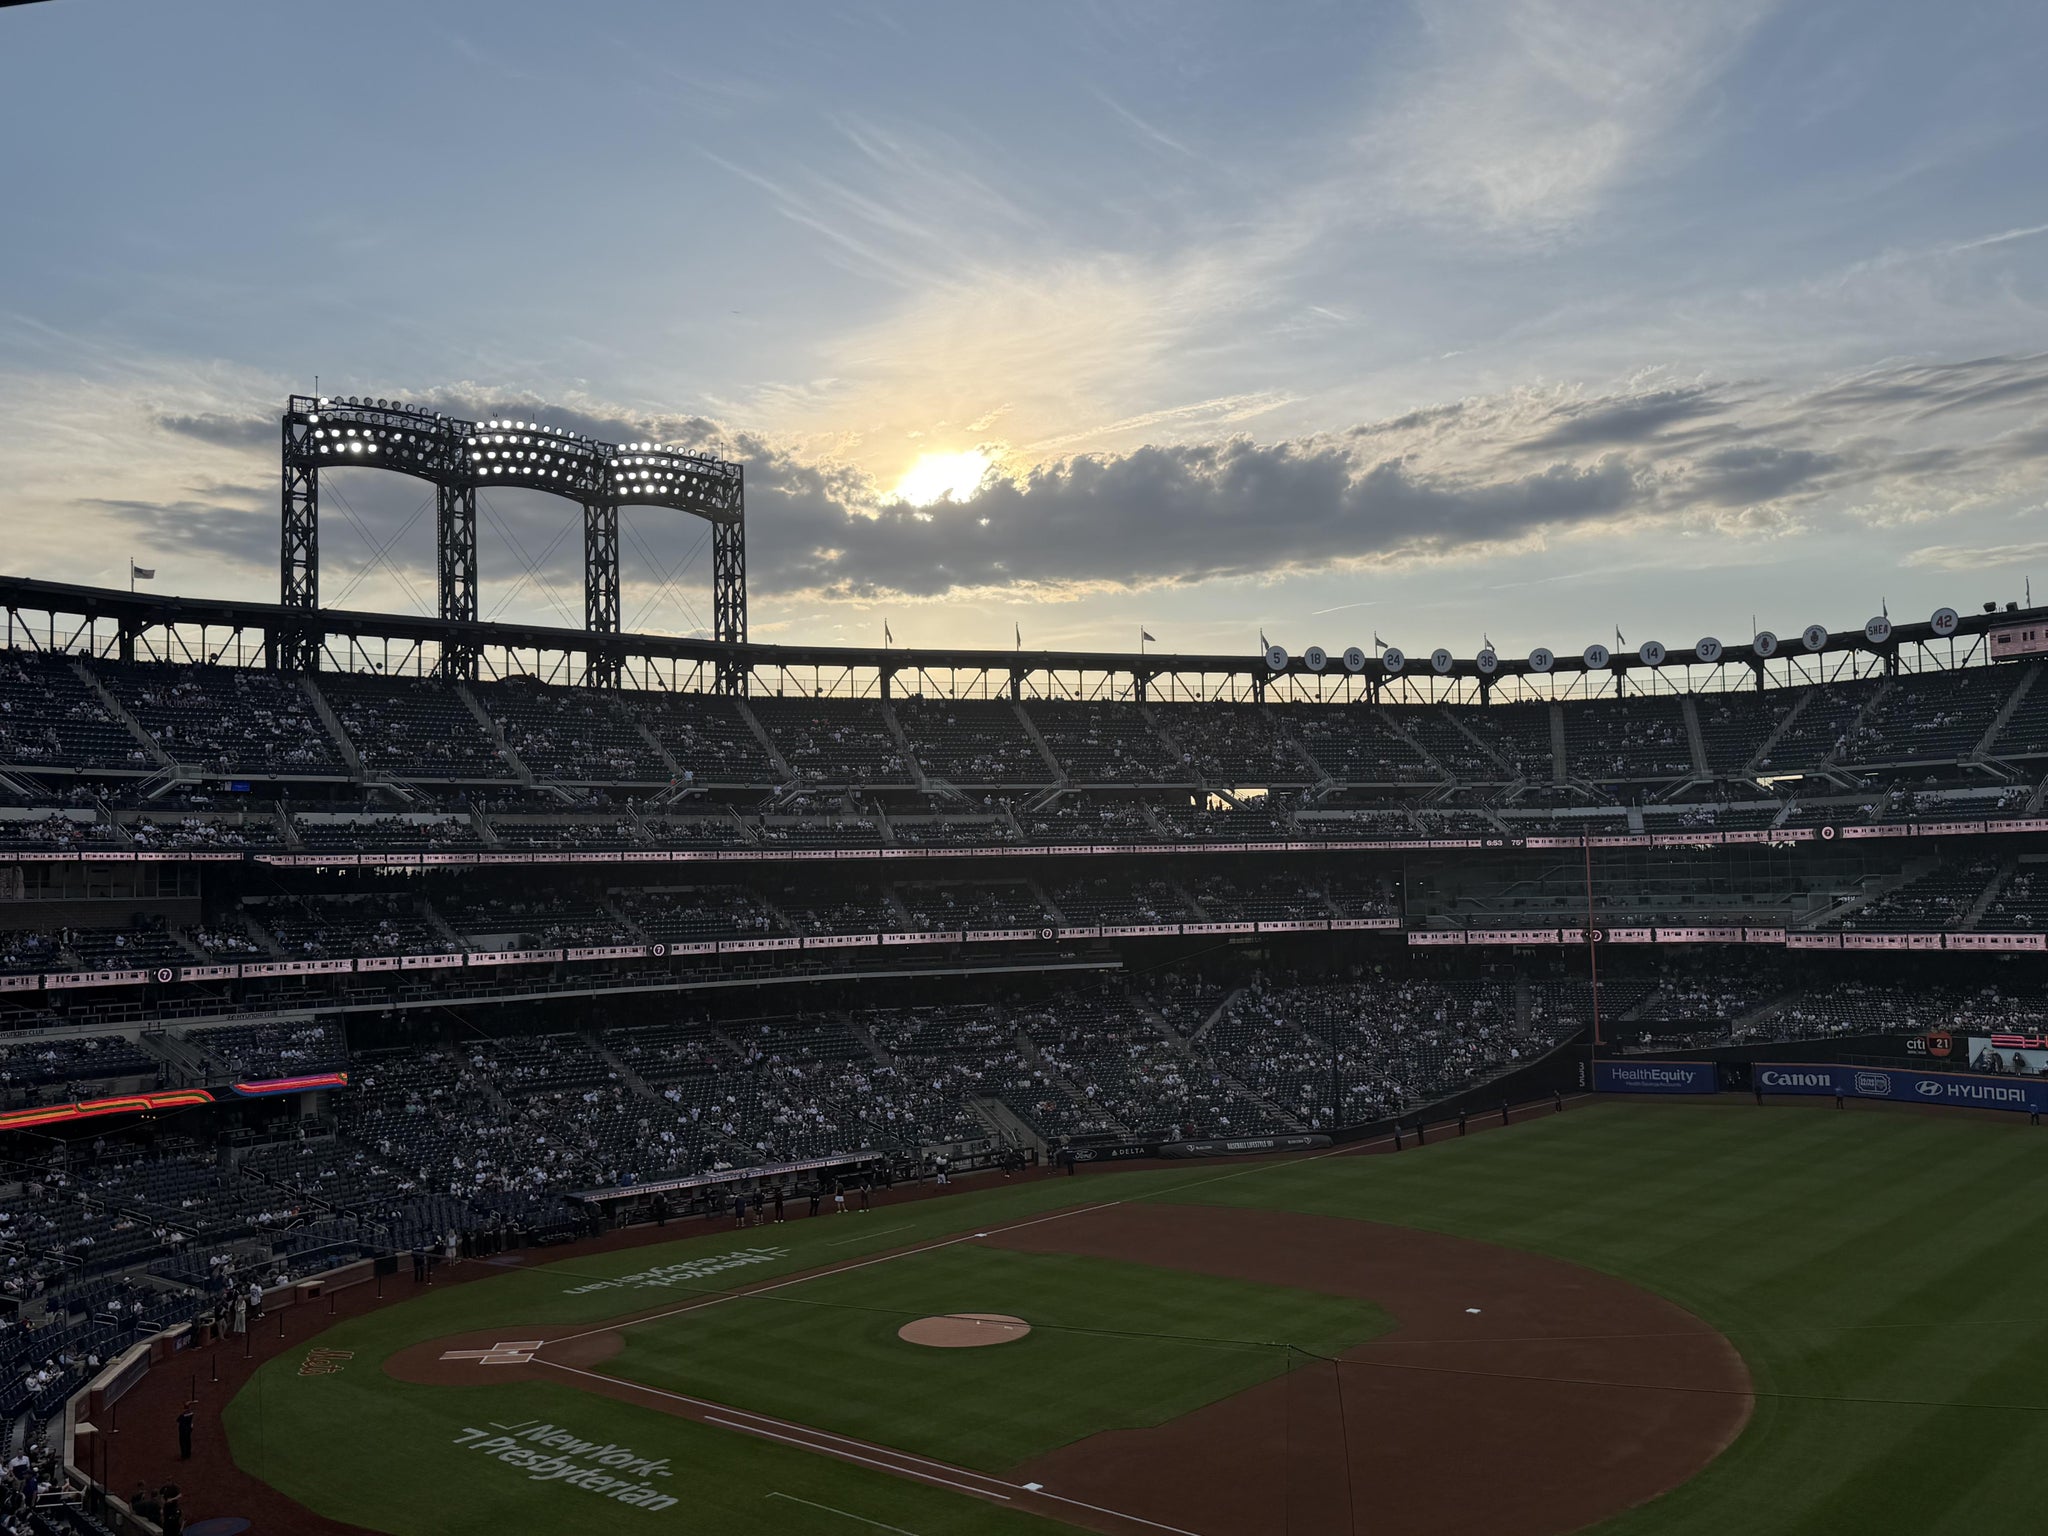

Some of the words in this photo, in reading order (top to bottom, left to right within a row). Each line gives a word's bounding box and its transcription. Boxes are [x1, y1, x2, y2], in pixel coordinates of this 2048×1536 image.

[1935, 615, 1953, 629] 42
[1867, 624, 1889, 636] SHEA
[1646, 648, 1659, 660] 14
[1701, 644, 1717, 656] 37
[1272, 652, 1281, 665] 5
[1310, 652, 1322, 665] 18
[1348, 653, 1360, 666] 16
[1387, 654, 1400, 667] 24
[1436, 655, 1448, 667] 17
[1481, 656, 1494, 668] 36
[1535, 654, 1548, 666] 31
[1590, 651, 1603, 663] 41
[1906, 1038, 1926, 1050] citi
[1936, 1038, 1949, 1049] 21
[1612, 1068, 1694, 1084] HealthEquity
[1762, 1071, 1831, 1086] Canon
[1948, 1084, 2026, 1102] HYUNDAI
[1074, 1151, 1093, 1160] Ford
[1119, 1147, 1145, 1155] DELTA
[468, 1436, 679, 1511] Presbyterian
